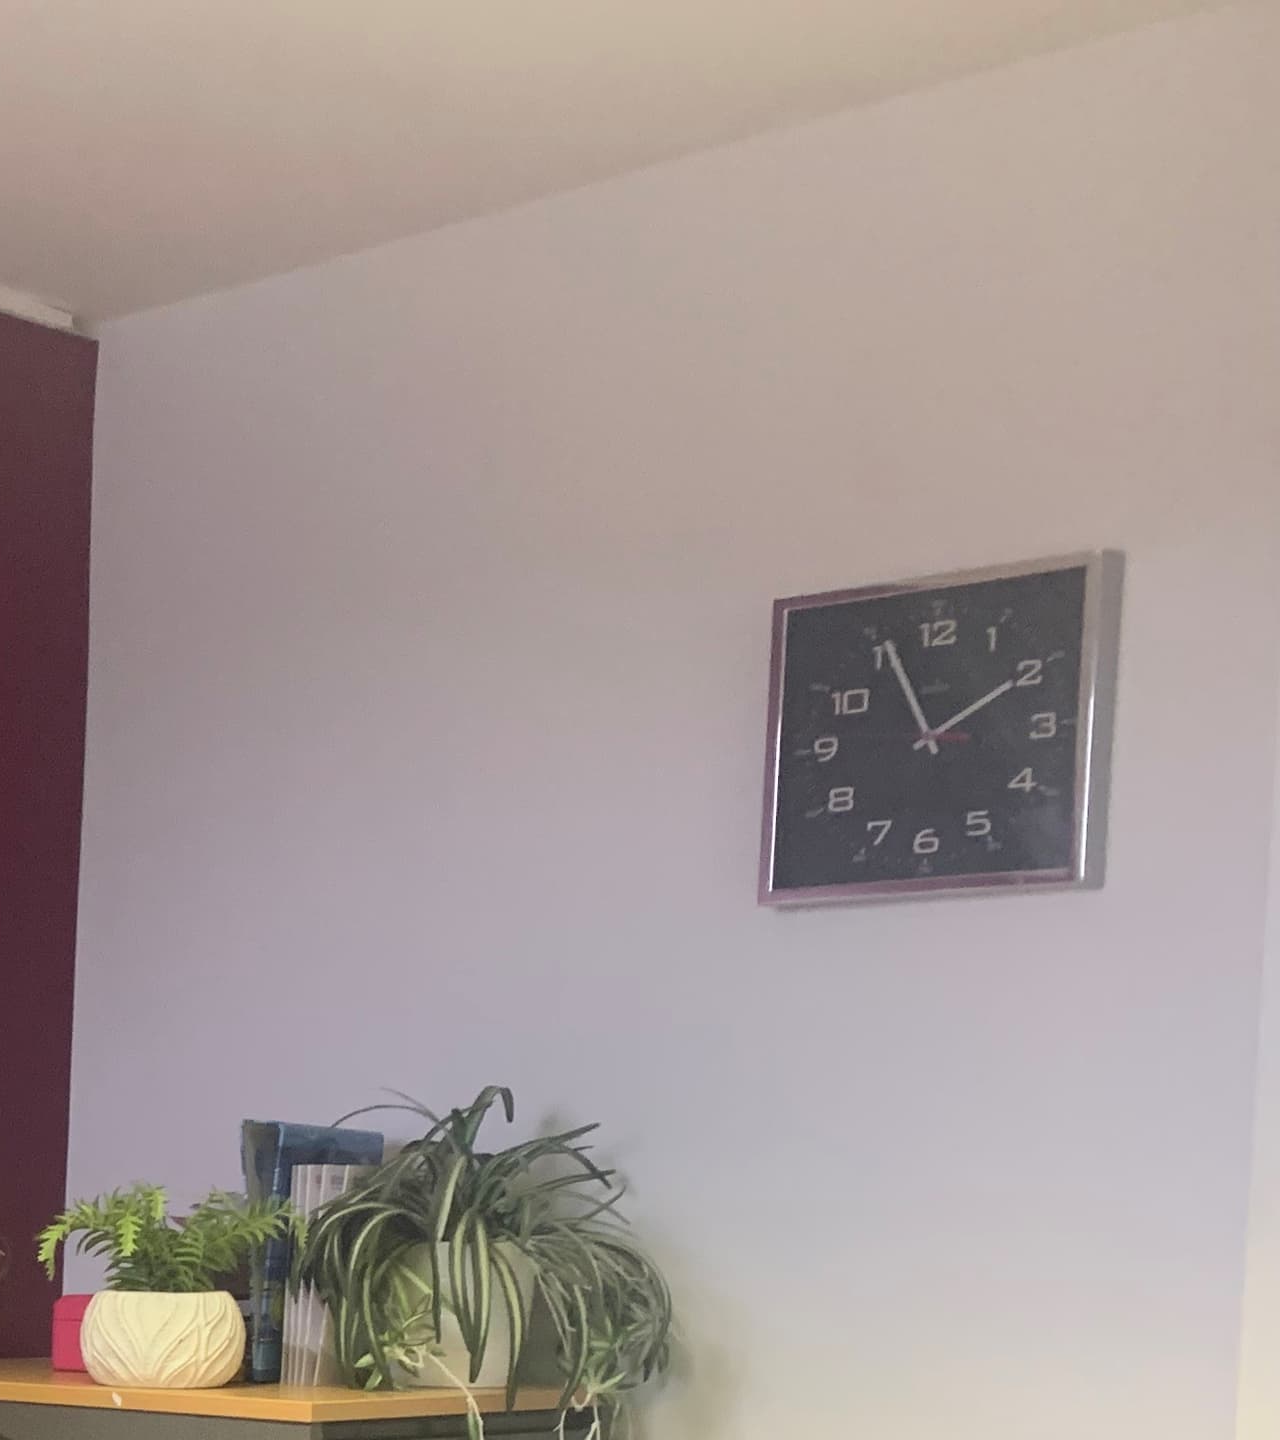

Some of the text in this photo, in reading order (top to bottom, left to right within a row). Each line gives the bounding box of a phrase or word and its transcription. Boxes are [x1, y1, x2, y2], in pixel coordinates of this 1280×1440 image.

[919, 619, 957, 648] 12
[986, 626, 998, 651] 1
[1017, 660, 1042, 686] 2
[832, 688, 869, 715] 10
[1029, 712, 1056, 739] 3
[813, 737, 838, 762] 9
[1007, 767, 1036, 792] 4
[827, 786, 854, 812] 8
[867, 820, 891, 845] 7
[965, 810, 991, 836] 5
[912, 828, 939, 853] 6
